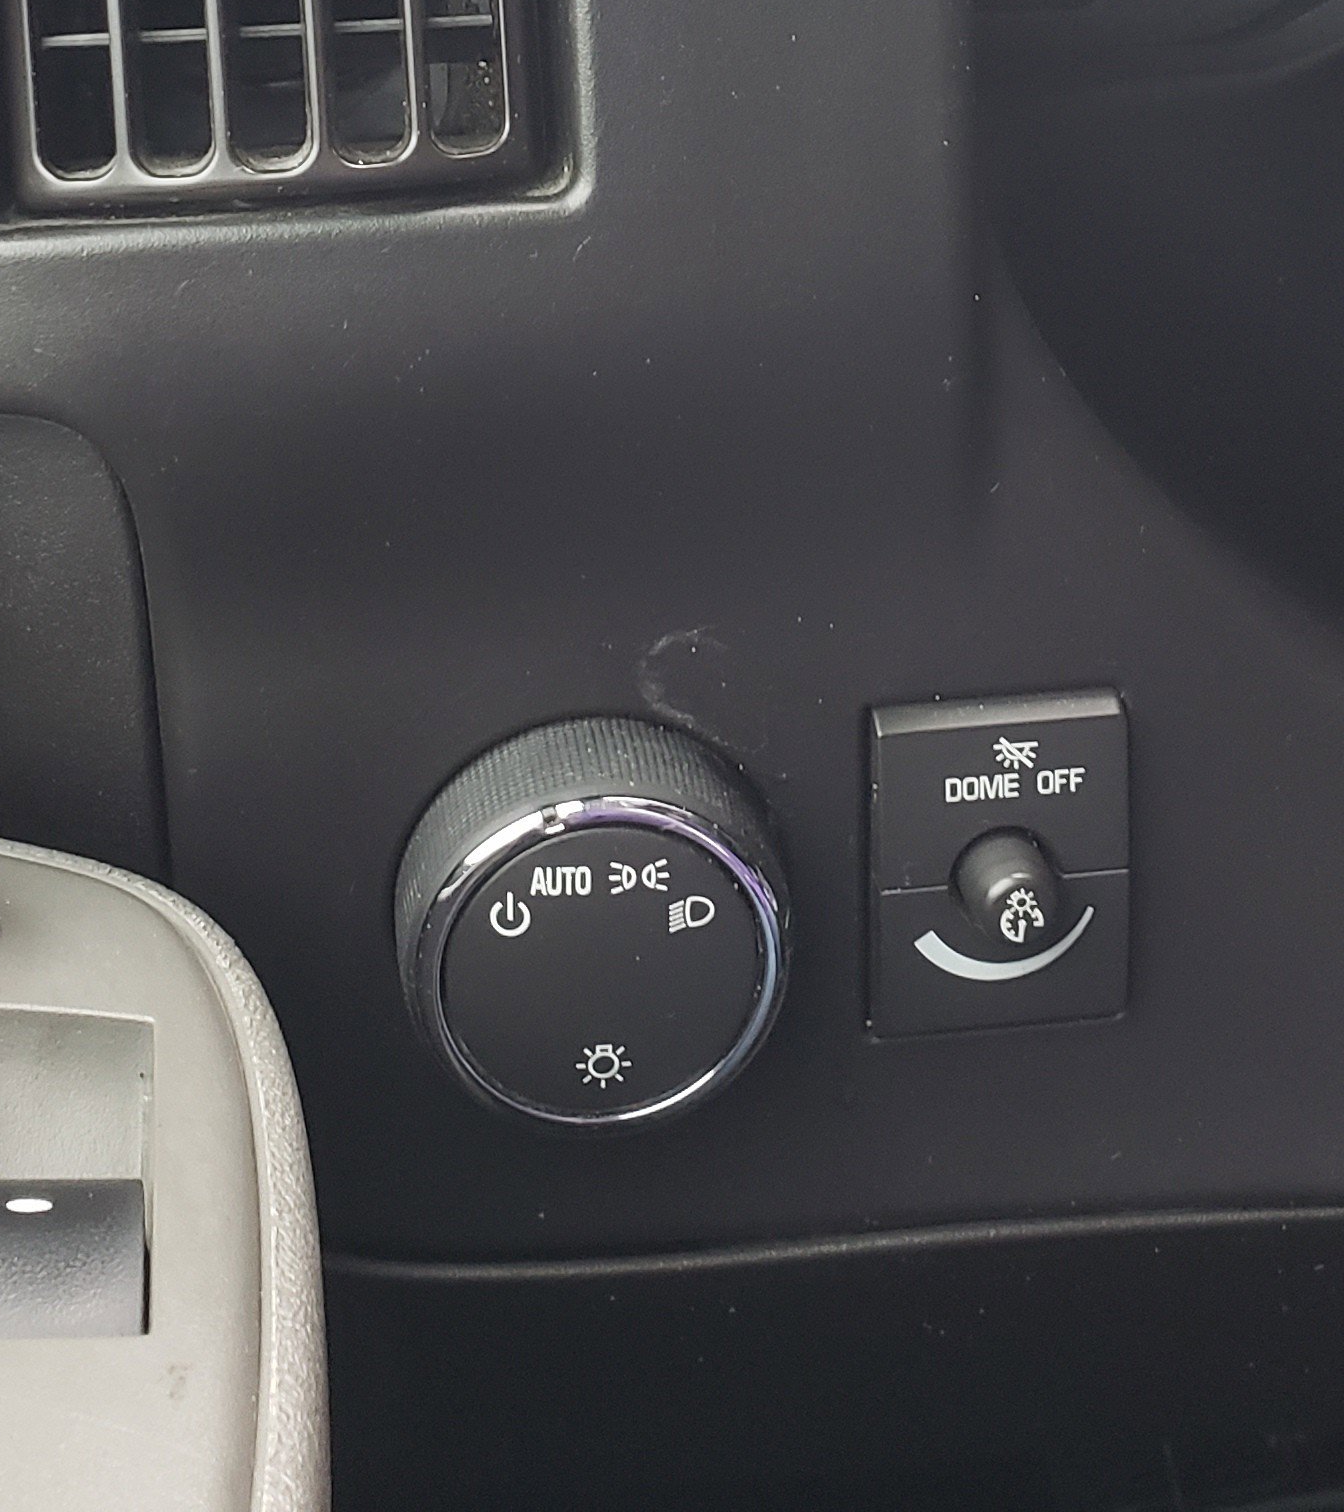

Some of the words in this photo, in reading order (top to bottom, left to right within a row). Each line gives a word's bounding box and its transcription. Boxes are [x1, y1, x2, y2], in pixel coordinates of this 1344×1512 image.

[944, 773, 1020, 804] DOME
[1036, 767, 1086, 796] OFF
[530, 866, 592, 897] AUTO
